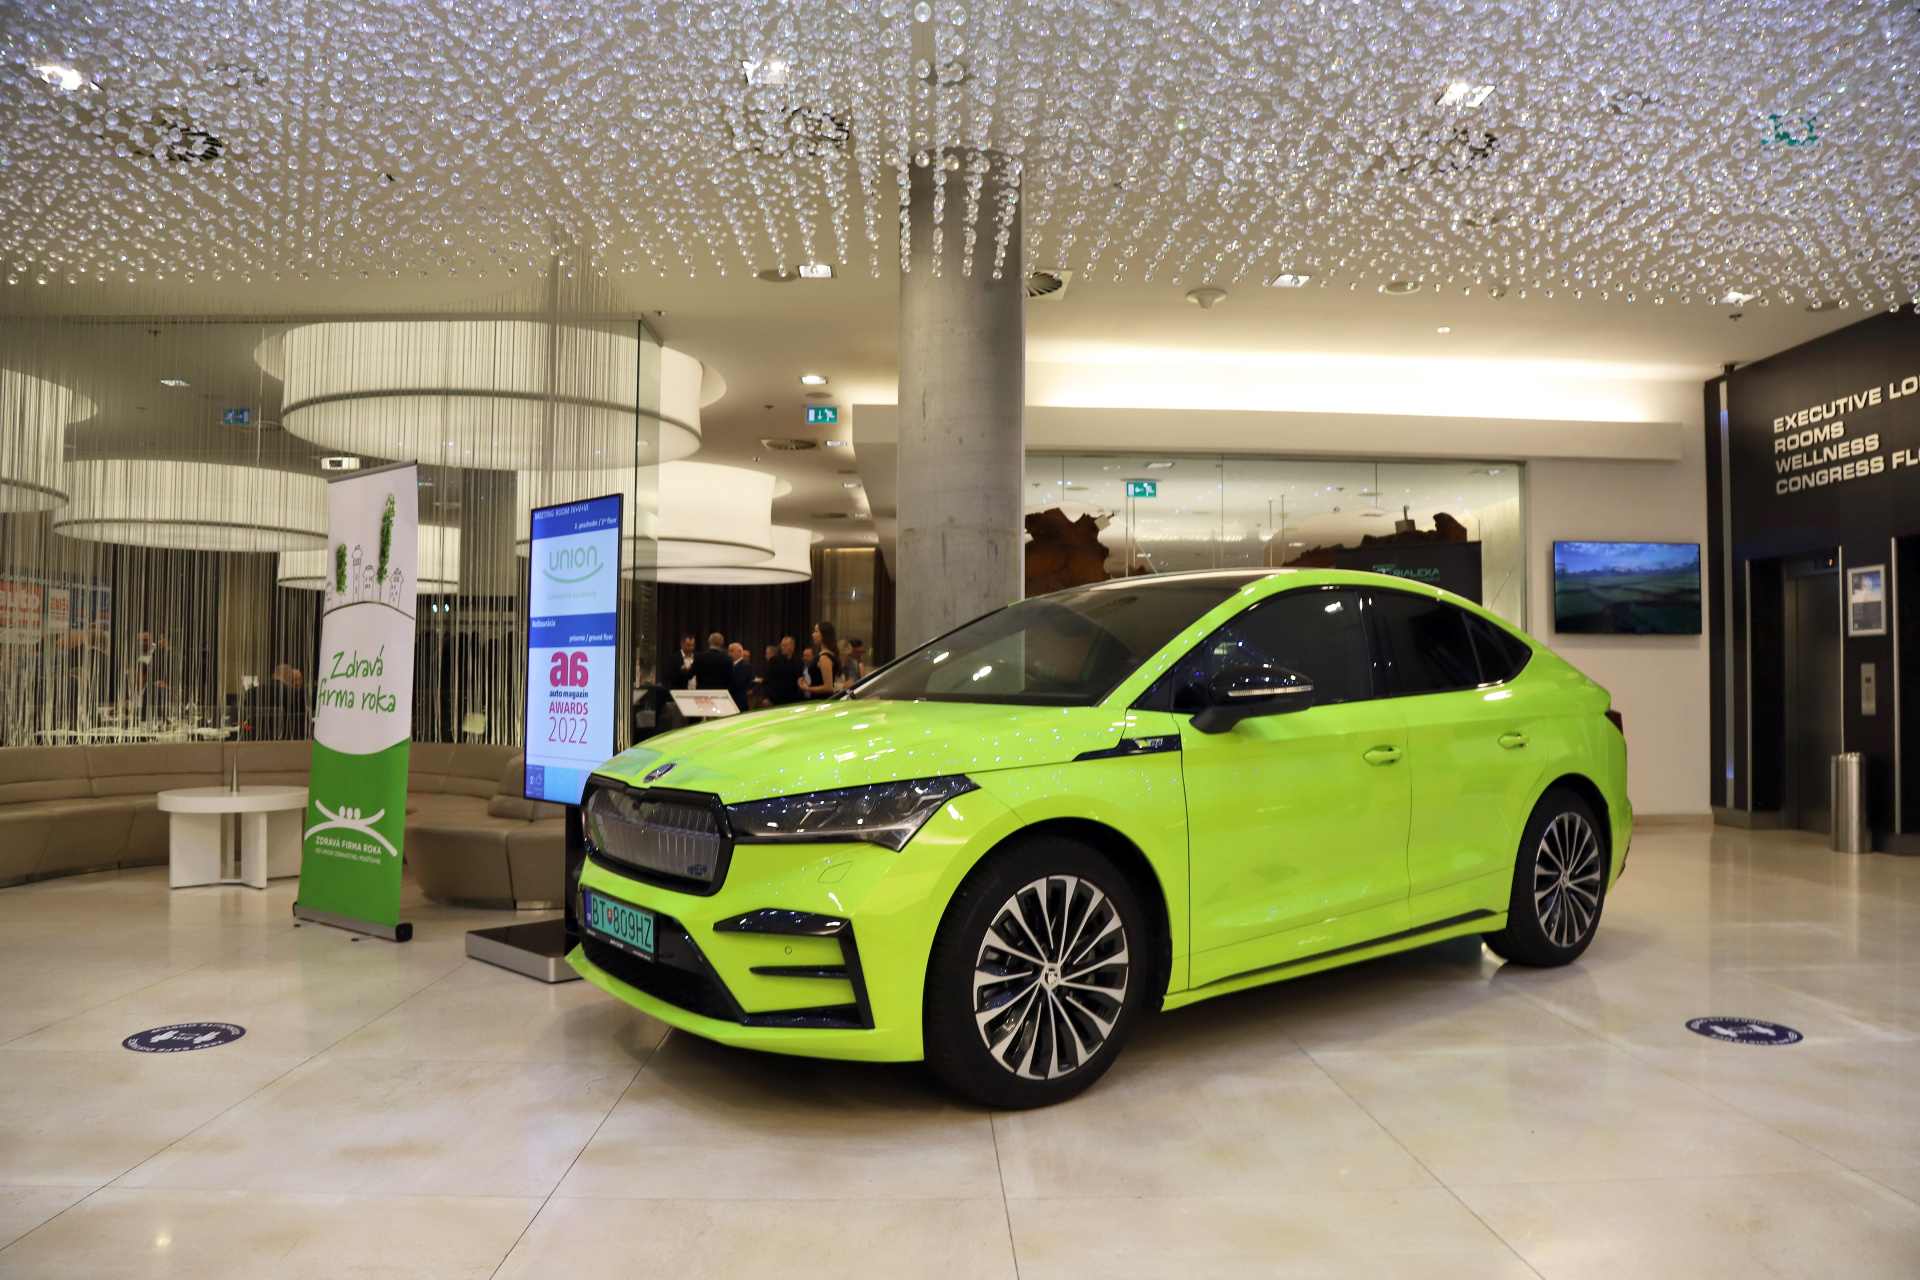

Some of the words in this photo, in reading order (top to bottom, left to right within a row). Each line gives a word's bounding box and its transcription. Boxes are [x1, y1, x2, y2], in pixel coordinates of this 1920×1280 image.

[1773, 386, 1882, 434] EXECUTIVE
[1889, 375, 1920, 400] LO
[1774, 421, 1845, 454] ROOMS
[1775, 433, 1880, 474] WELLNESS
[1776, 455, 1885, 495] CONGRESS
[1892, 448, 1920, 470] FL
[330, 644, 384, 679] Zdravá
[317, 678, 354, 717] firma
[361, 684, 396, 714] roka
[549, 701, 589, 715] AWARDS
[549, 716, 588, 744] 2022
